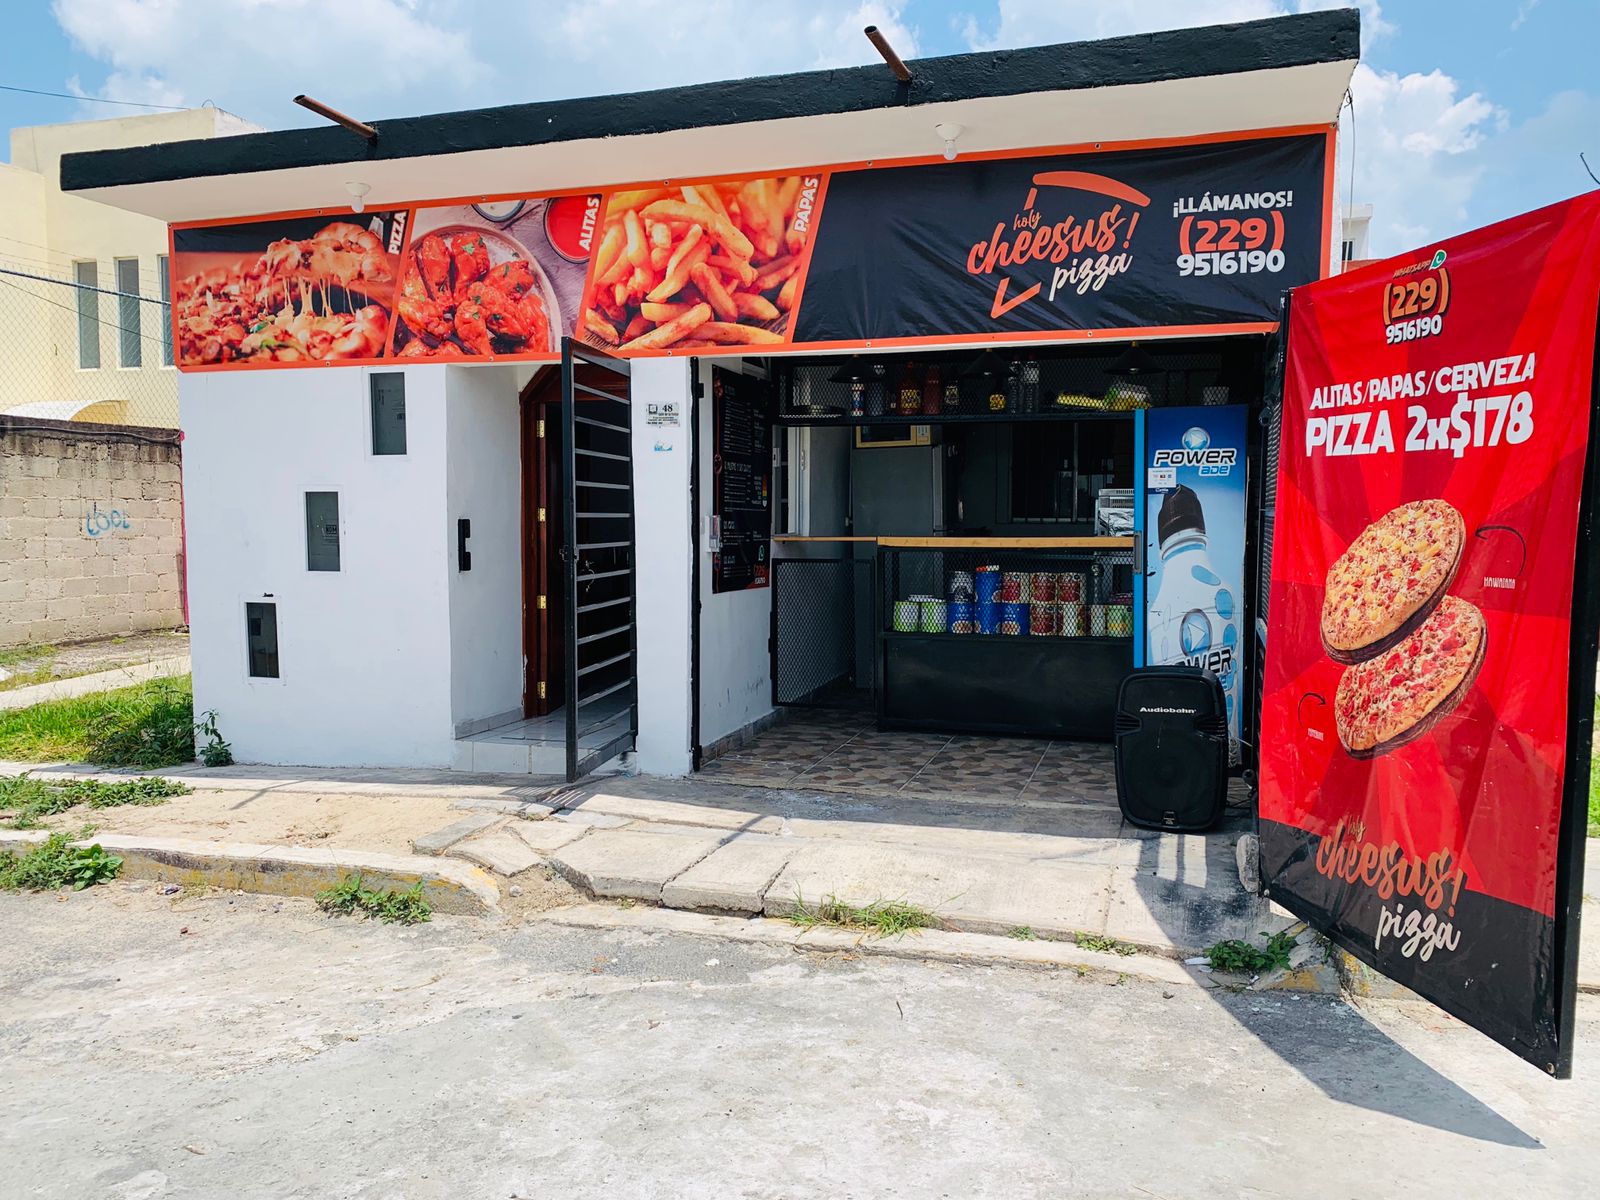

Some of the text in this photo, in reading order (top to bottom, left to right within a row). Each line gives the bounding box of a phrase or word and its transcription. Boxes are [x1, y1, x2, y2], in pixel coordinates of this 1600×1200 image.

[578, 196, 600, 252] ALITAS
[793, 177, 818, 232] PAPAS
[1012, 211, 1042, 231] holy
[1173, 190, 1293, 218] ¡LLÁMANOS!
[388, 211, 407, 255] PIZZA
[966, 203, 1140, 276] cheesus!
[1179, 211, 1286, 255] (229)
[1048, 252, 1133, 302] pizza
[1176, 250, 1286, 276] 9516190
[1383, 268, 1449, 325] (229)
[1385, 313, 1443, 344] 9516190
[662, 403, 673, 413] 48
[1305, 390, 1534, 458] PIZZA 2x$178
[1154, 448, 1236, 466] POWER
[1174, 648, 1232, 674] WER
[1139, 705, 1196, 714] Audiobahn
[1315, 818, 1465, 918] cheesus!
[1374, 903, 1463, 962] pizza
